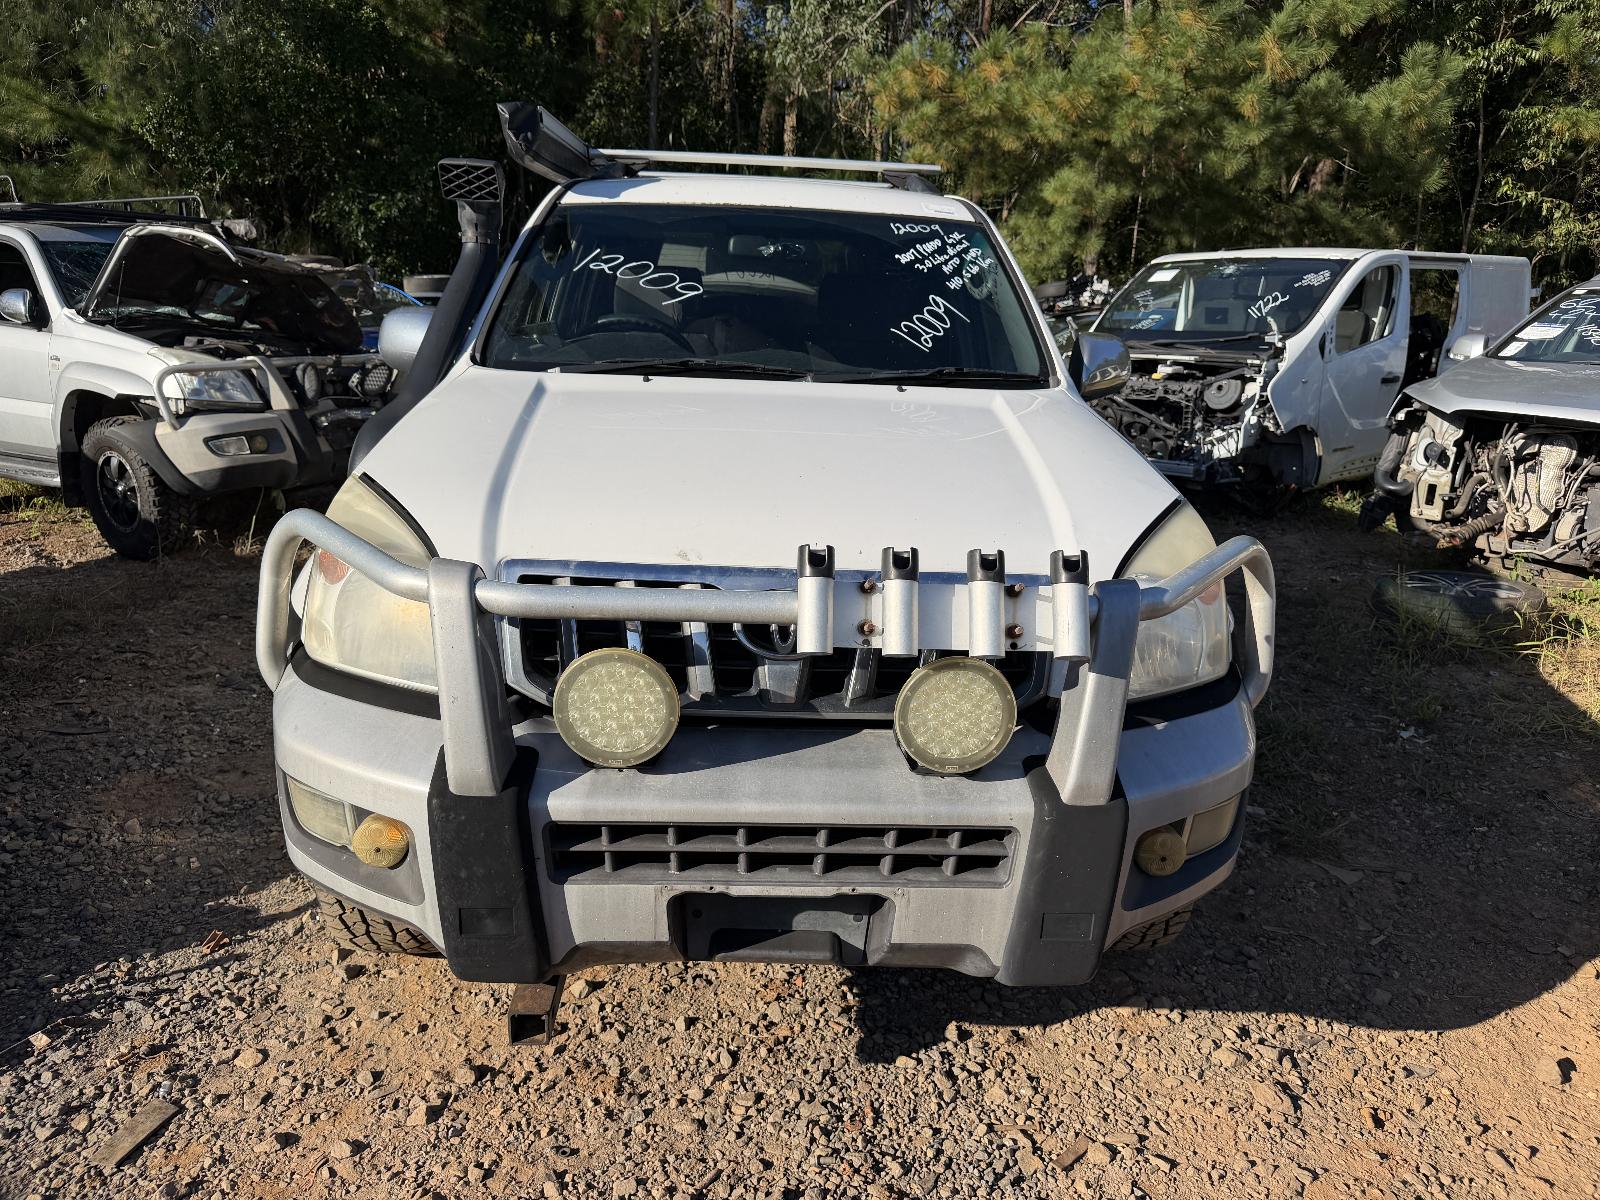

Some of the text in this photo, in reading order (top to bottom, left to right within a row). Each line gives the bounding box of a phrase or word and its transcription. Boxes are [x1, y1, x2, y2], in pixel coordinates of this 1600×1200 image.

[890, 223, 944, 235] 12009
[895, 232, 966, 264] 2007 PRADO GXL
[942, 248, 982, 275] AUTO 4WD
[573, 248, 704, 305] 12009
[1247, 291, 1290, 318] 11722
[890, 294, 971, 352] 12009
